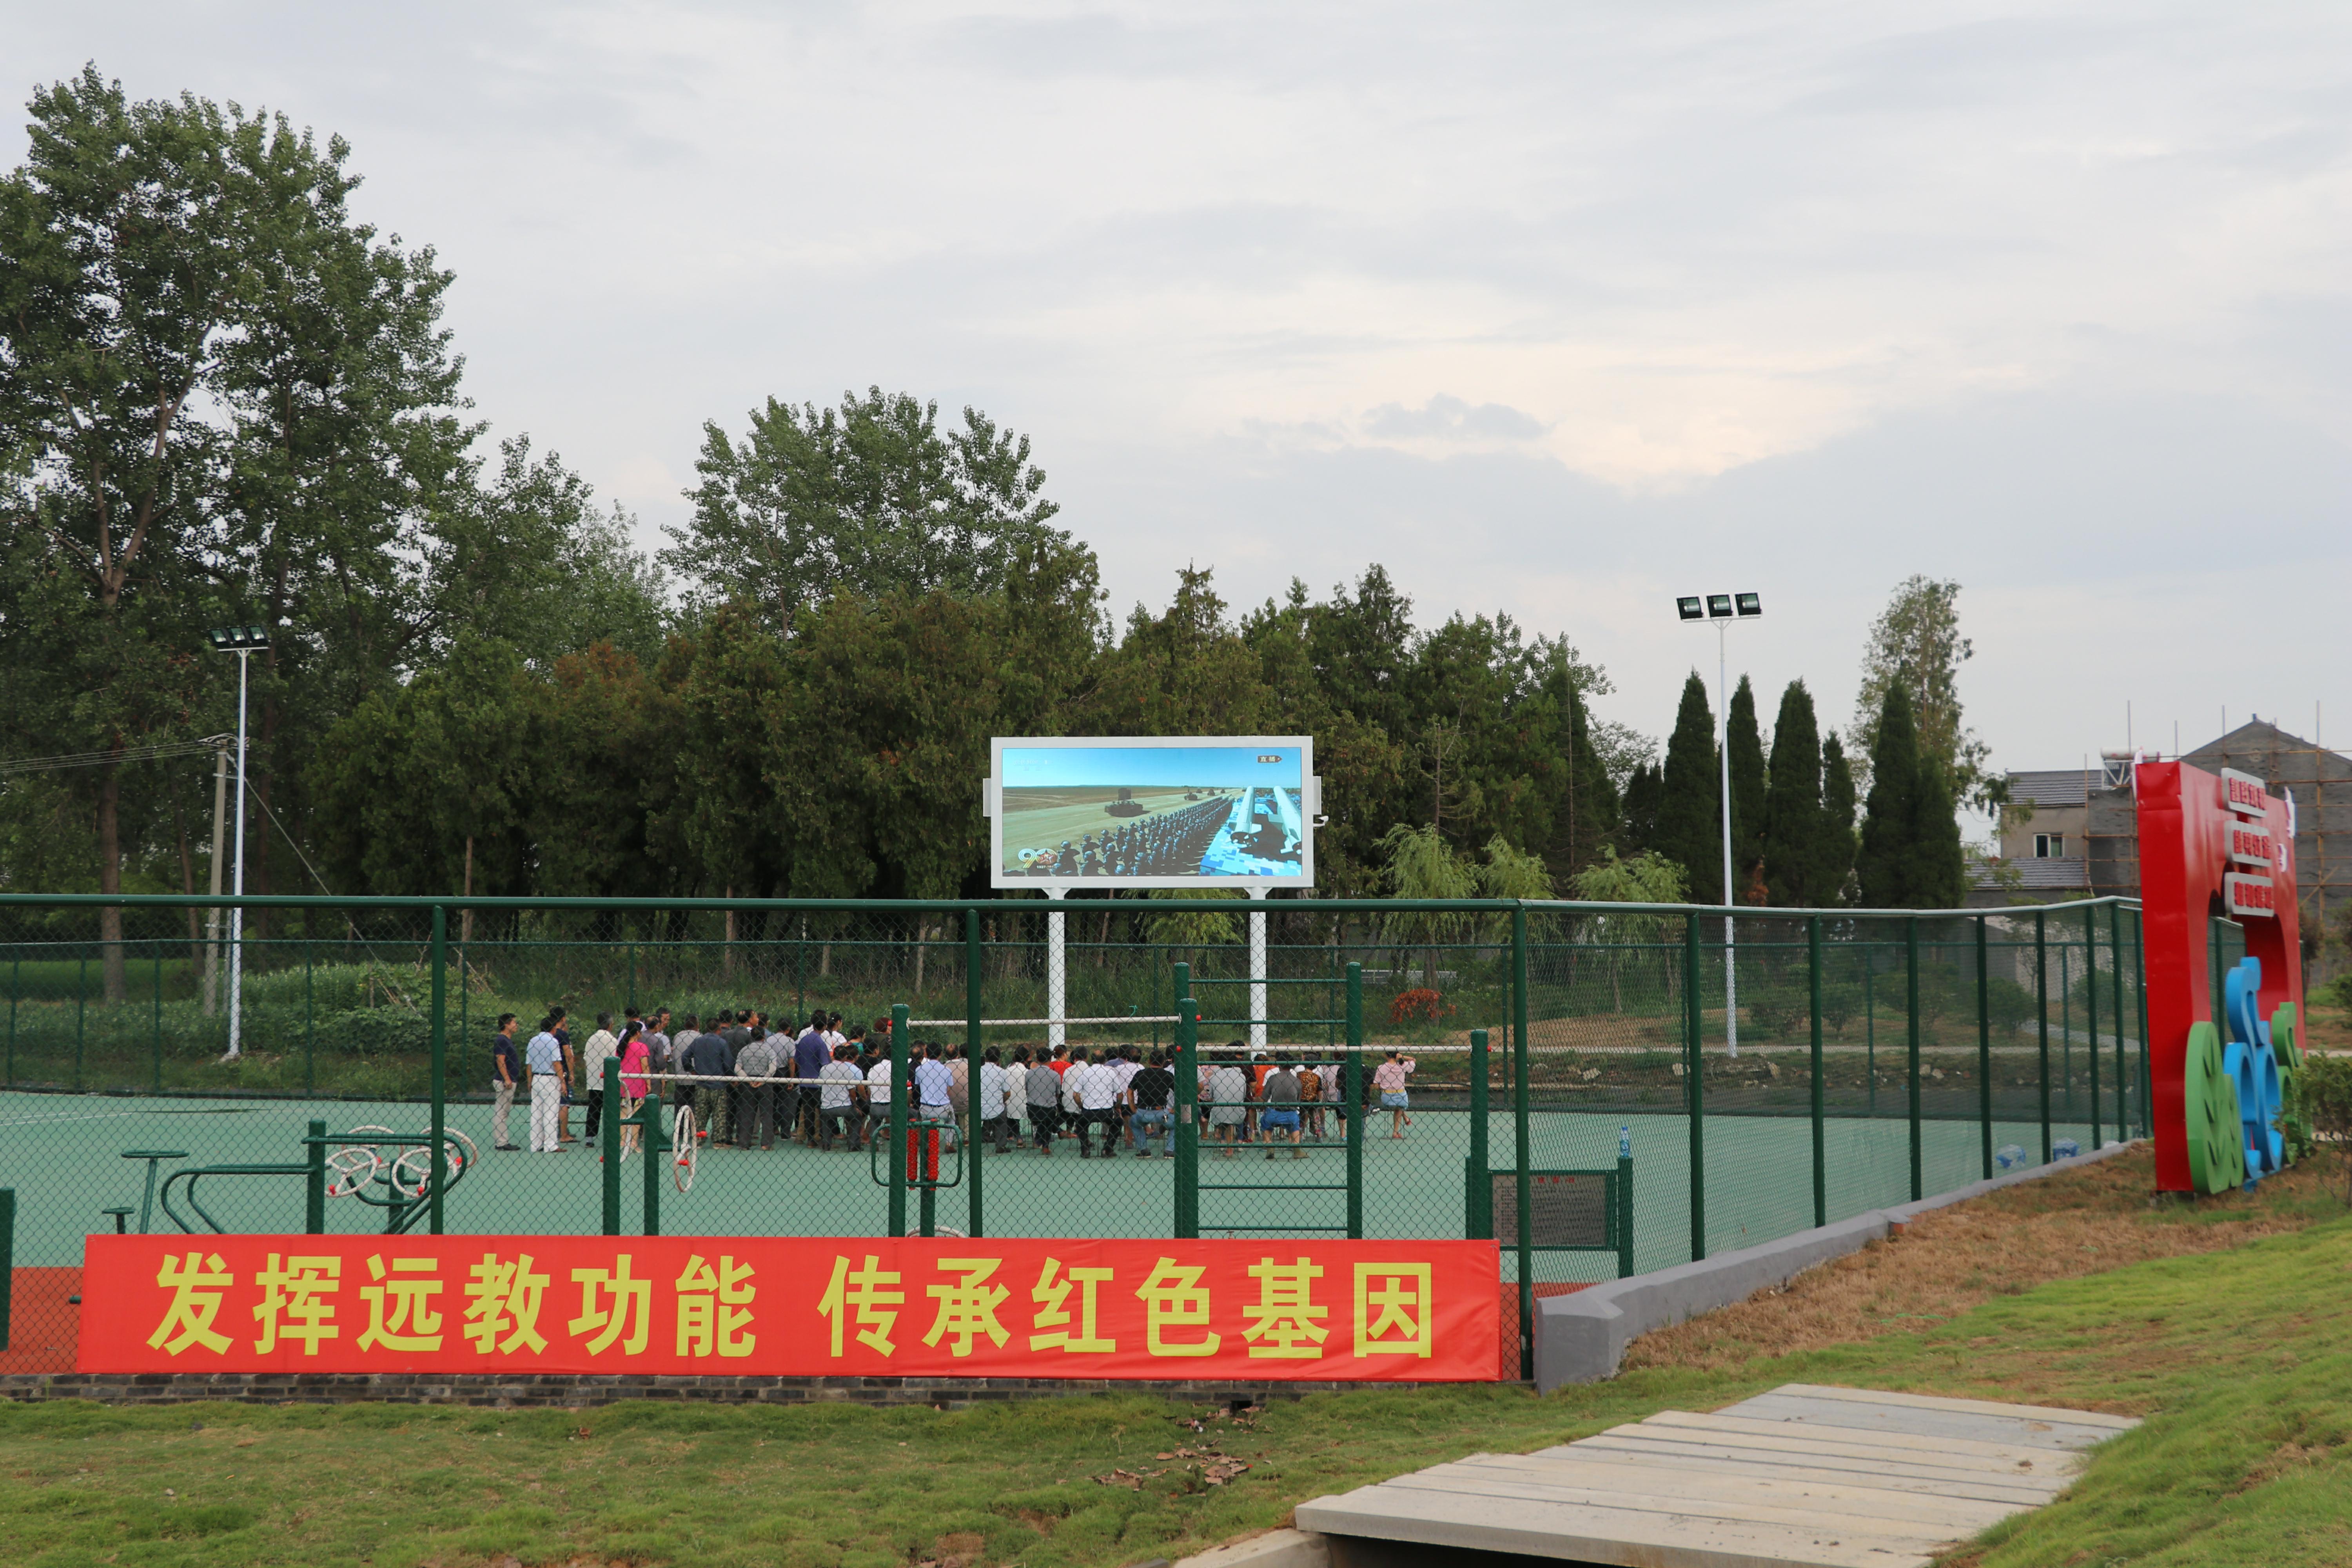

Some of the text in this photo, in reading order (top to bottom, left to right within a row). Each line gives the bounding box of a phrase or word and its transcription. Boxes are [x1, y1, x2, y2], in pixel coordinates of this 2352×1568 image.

[146, 1252, 1432, 1358] 发挥远教功能 传承红色基因
